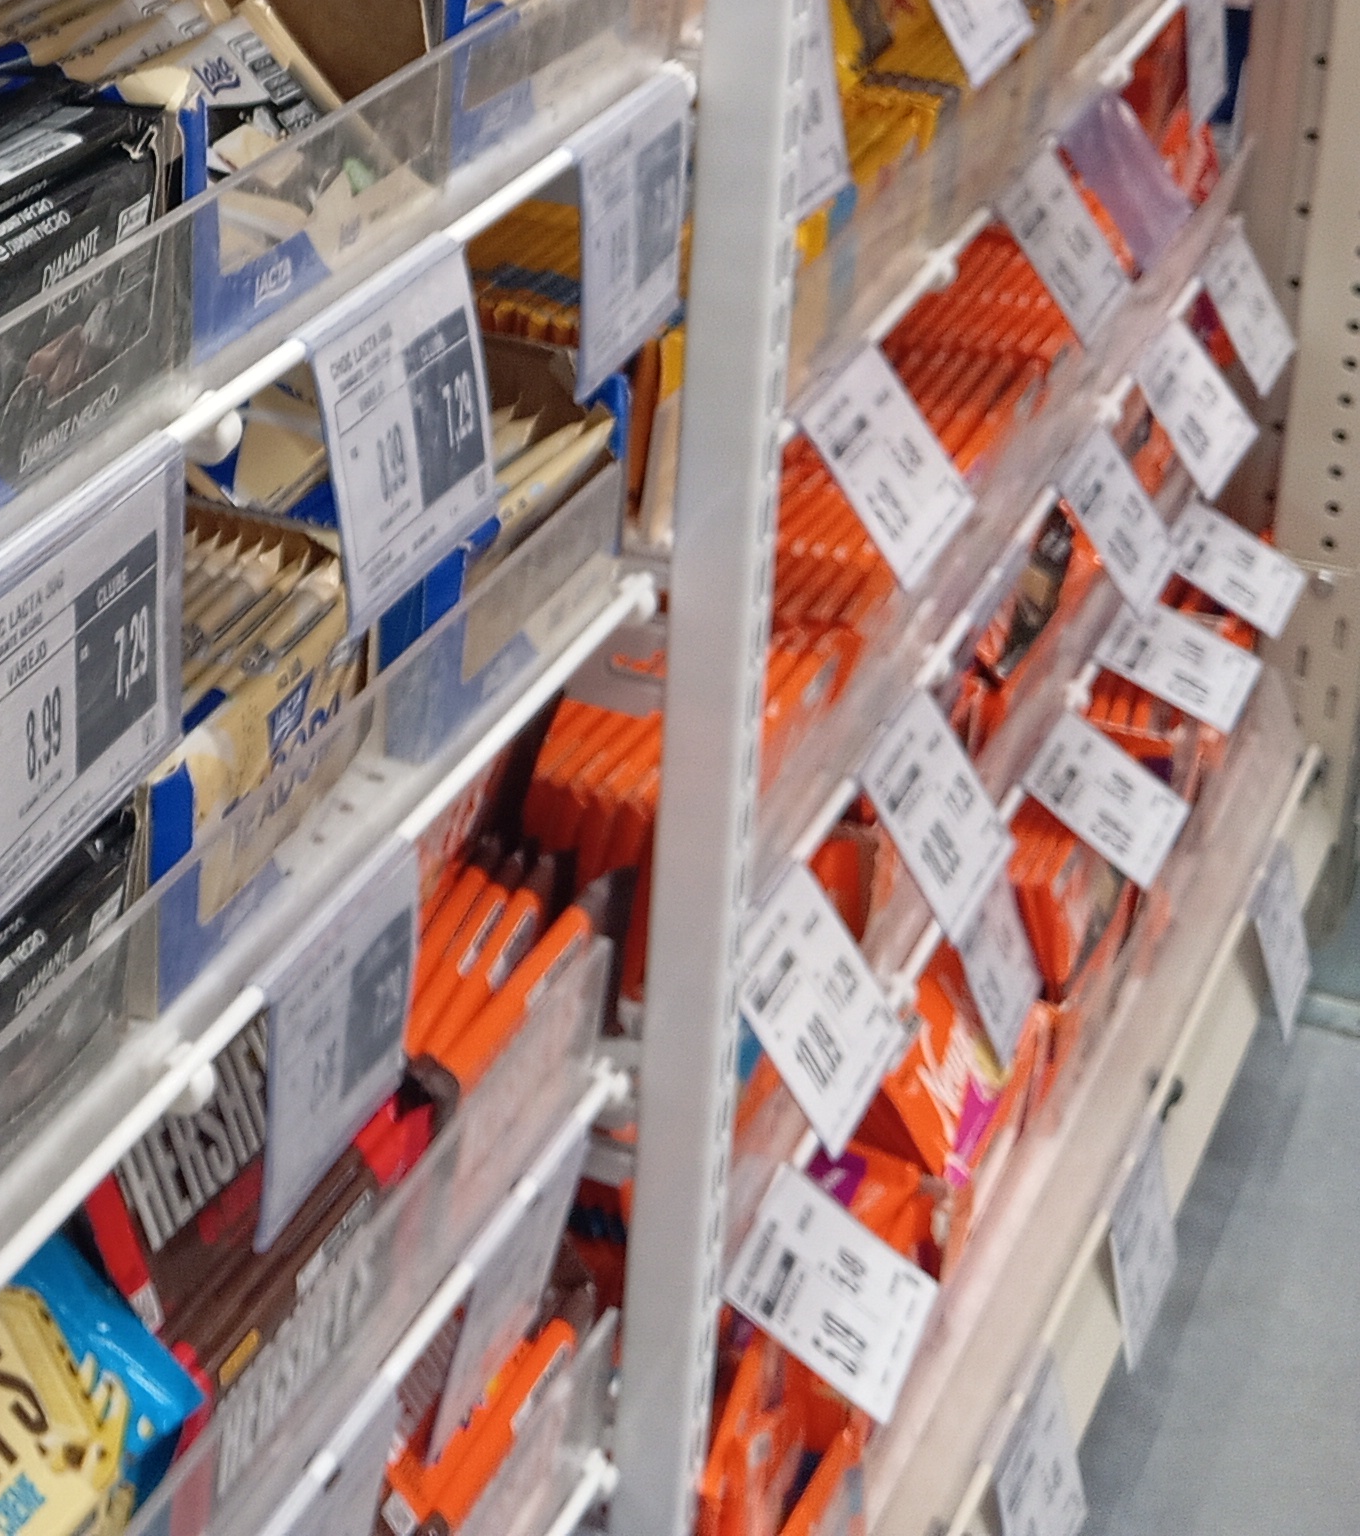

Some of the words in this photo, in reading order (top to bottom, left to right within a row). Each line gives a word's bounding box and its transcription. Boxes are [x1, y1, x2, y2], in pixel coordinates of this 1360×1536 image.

[7, 640, 48, 687] VAREJO
[113, 604, 149, 701] 7,29
[25, 684, 62, 785] 8,99
